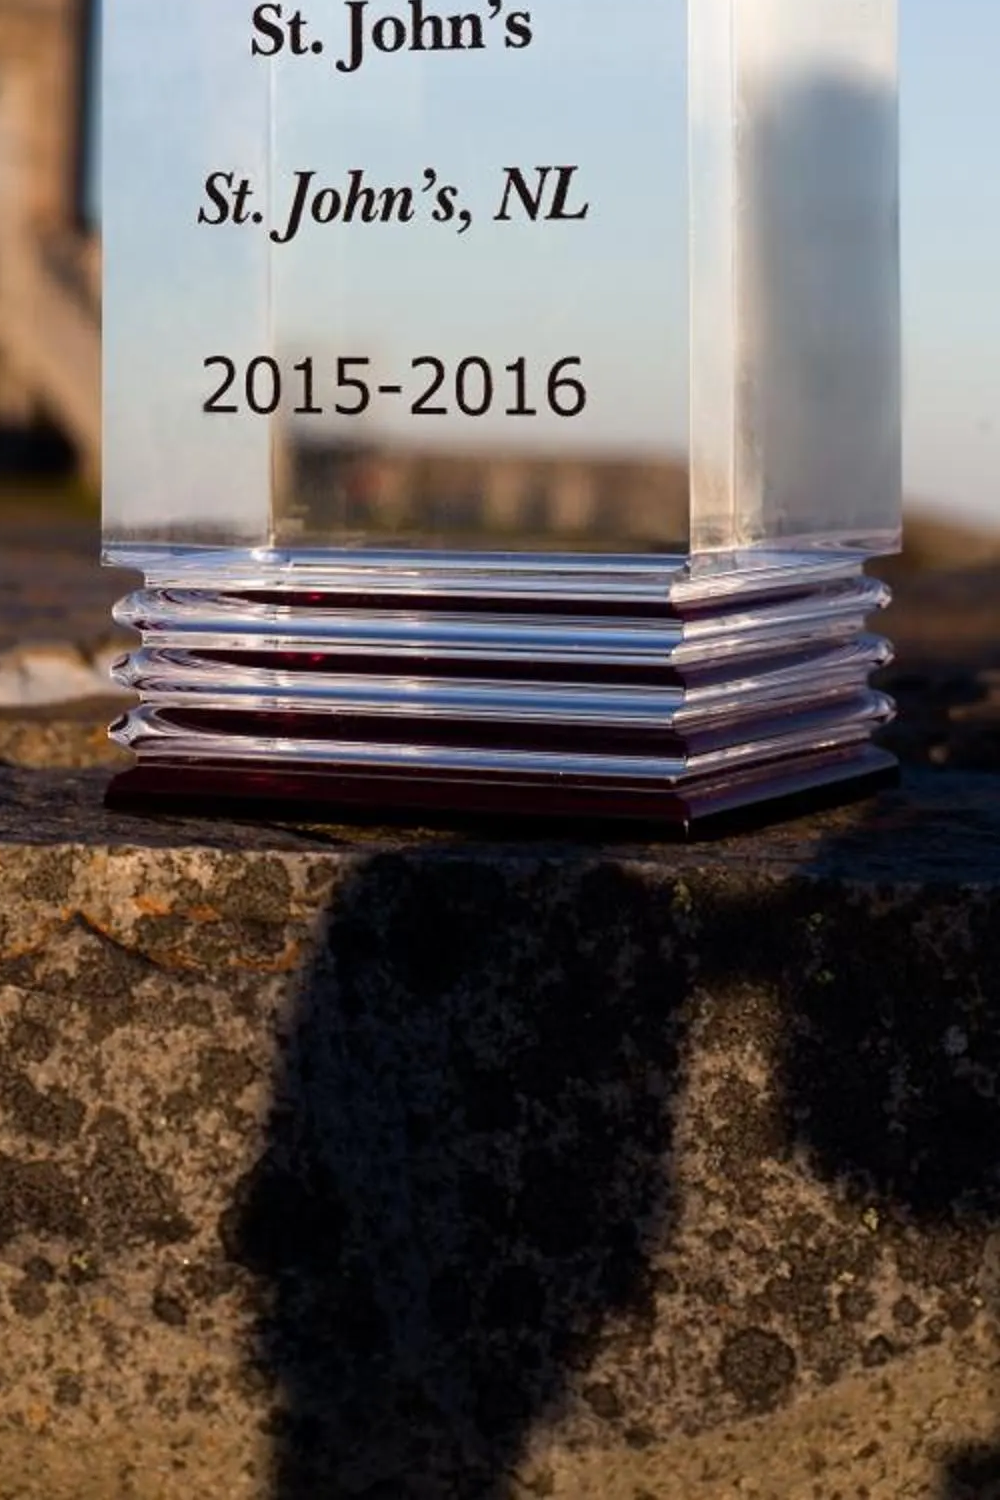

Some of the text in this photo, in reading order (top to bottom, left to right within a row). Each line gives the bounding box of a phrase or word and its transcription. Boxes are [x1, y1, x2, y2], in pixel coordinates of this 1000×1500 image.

[251, 3, 324, 57] St.
[197, 165, 590, 245] St. John's, NL
[202, 355, 587, 418] 2015-2016
